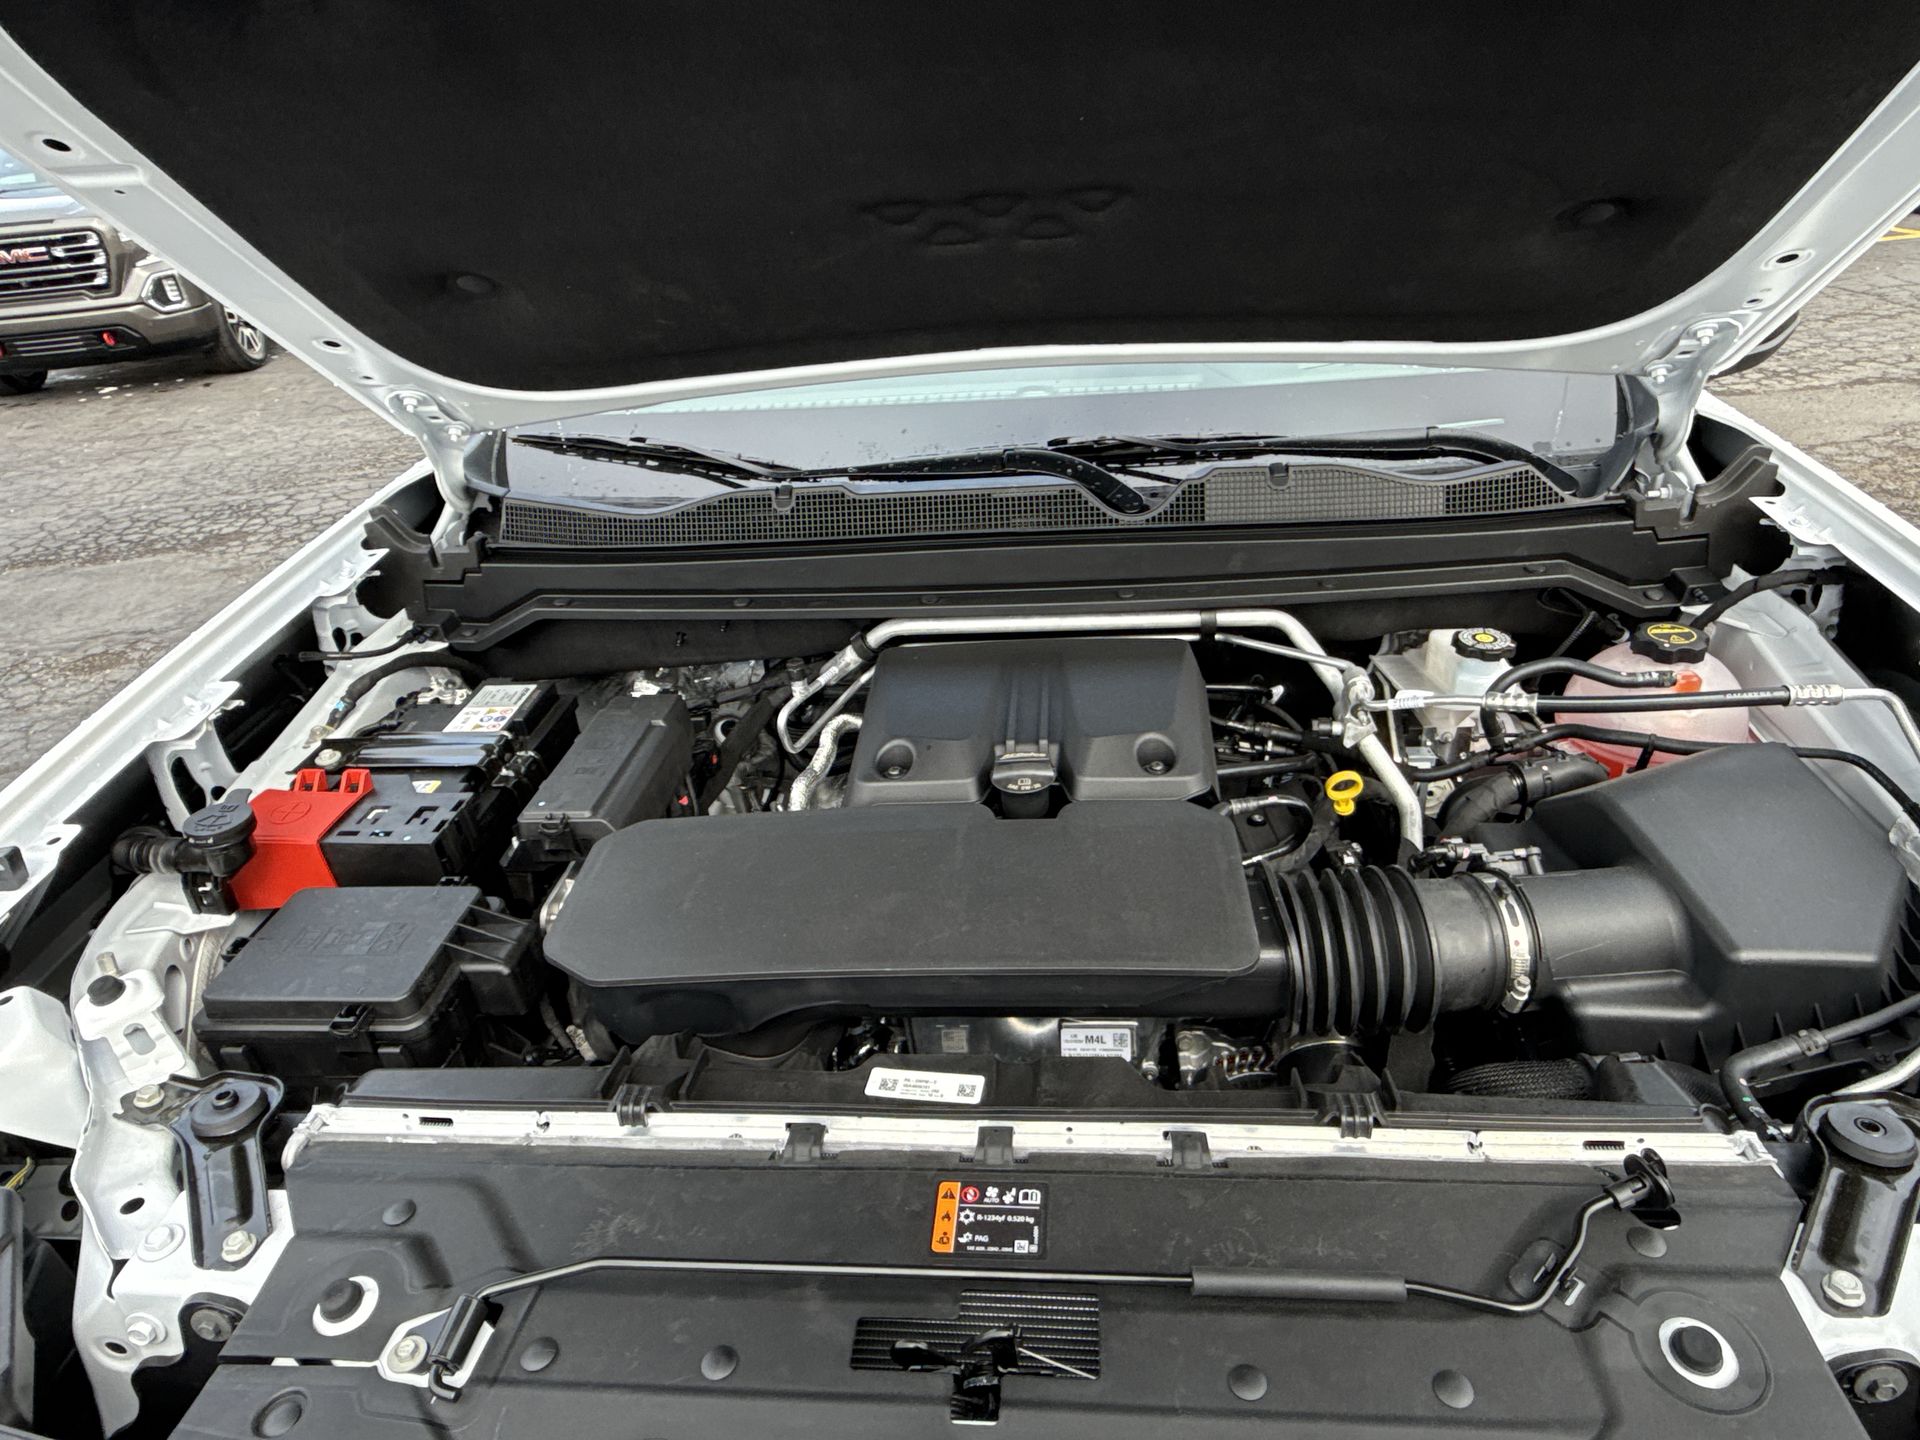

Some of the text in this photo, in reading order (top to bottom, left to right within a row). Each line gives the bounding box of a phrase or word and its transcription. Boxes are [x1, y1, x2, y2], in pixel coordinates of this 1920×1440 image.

[0, 246, 49, 264] MC
[1084, 1035, 1107, 1045] M4L
[1025, 1215, 1035, 1225] kg
[974, 1234, 989, 1243] PAG
